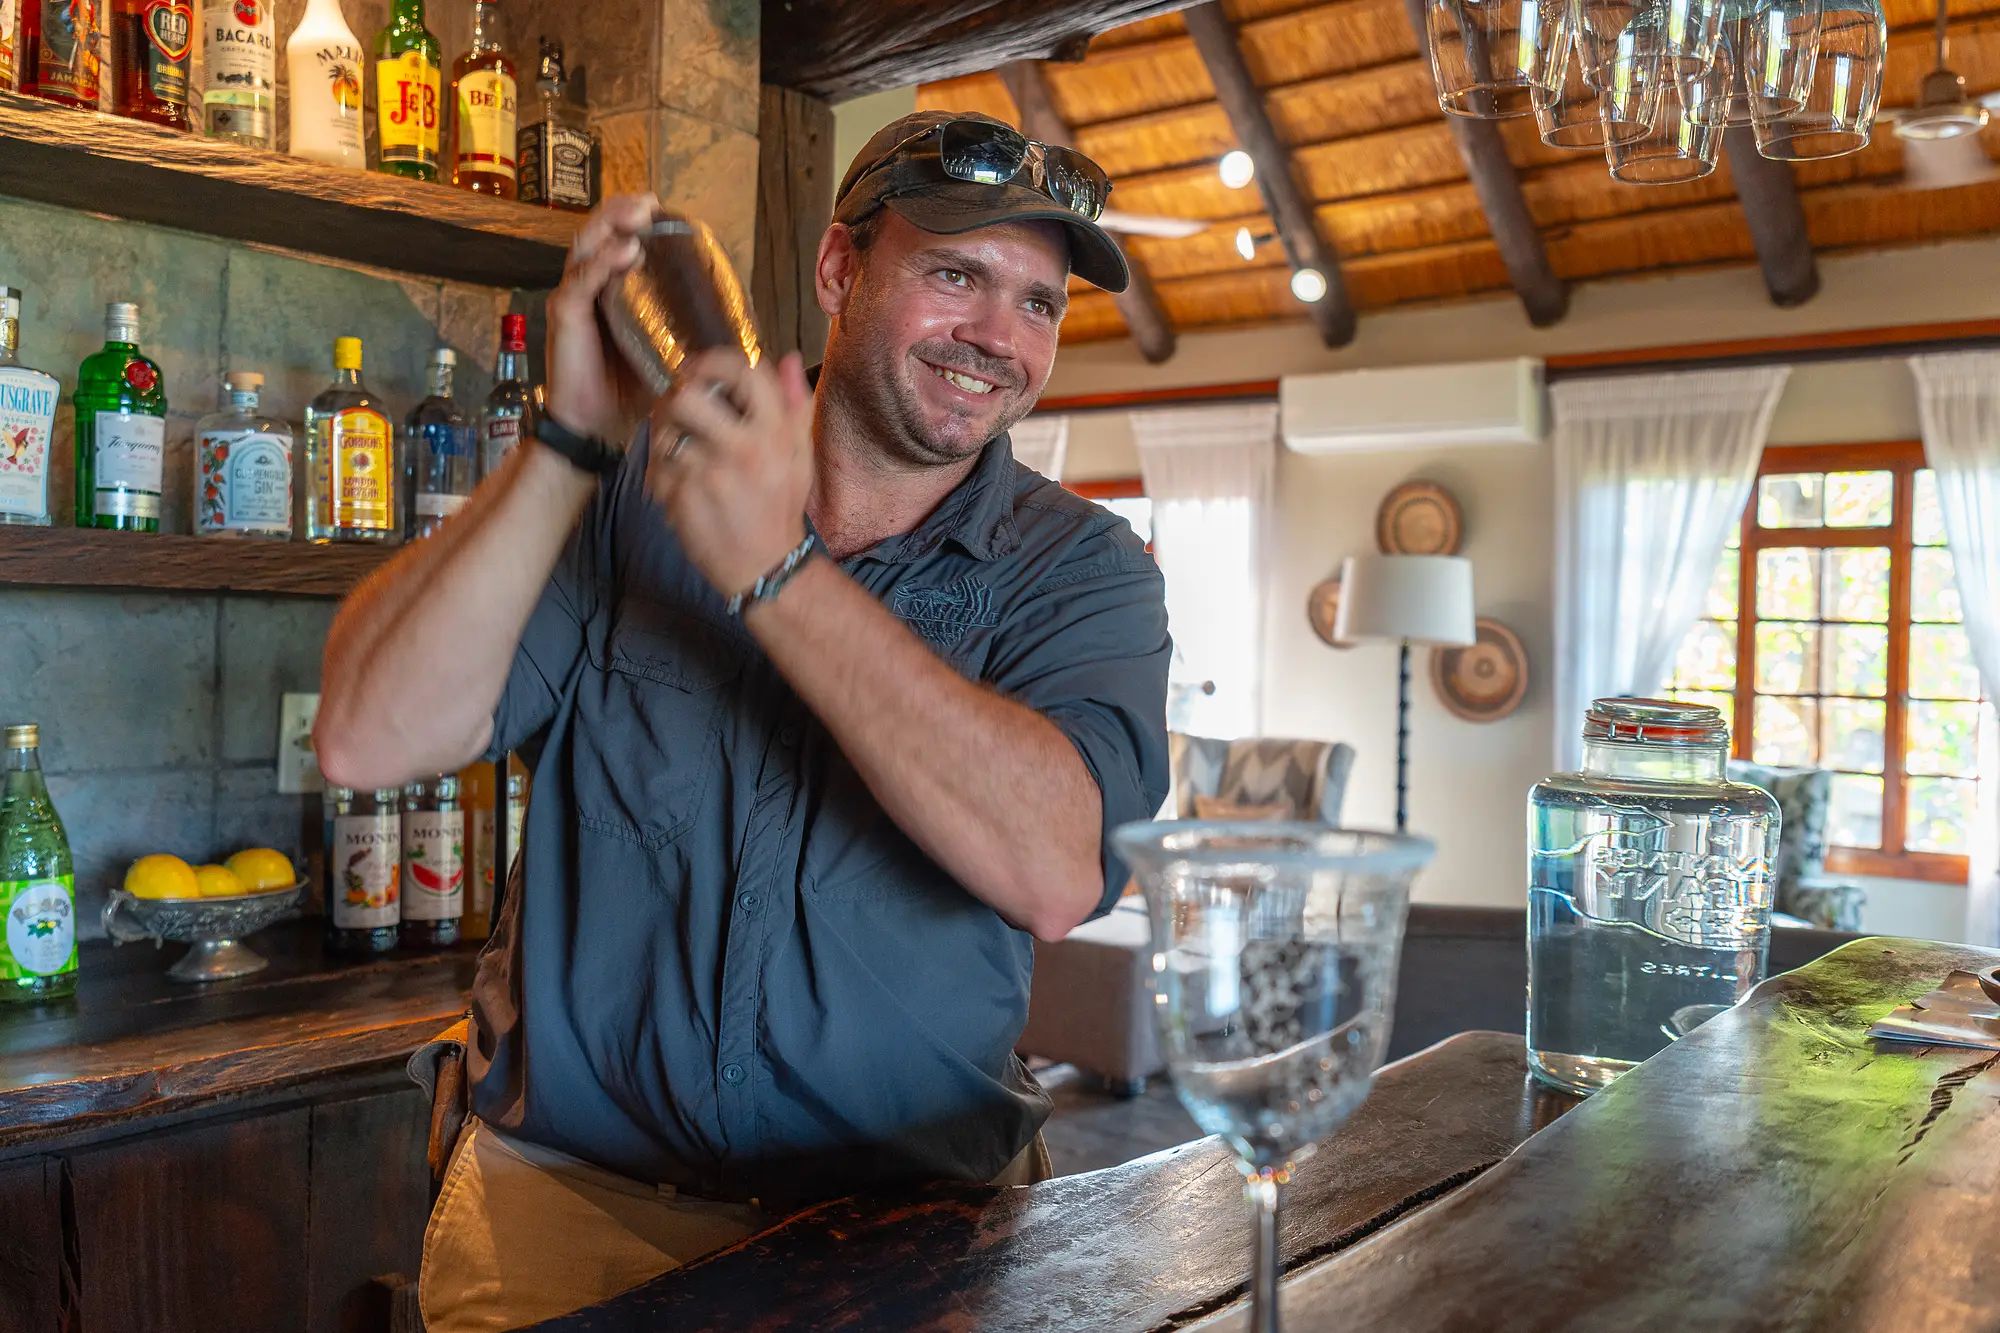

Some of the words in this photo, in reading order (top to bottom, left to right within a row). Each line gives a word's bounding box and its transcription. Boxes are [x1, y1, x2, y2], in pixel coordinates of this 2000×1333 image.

[160, 12, 187, 35] RED
[390, 80, 435, 129] J&B
[0, 384, 52, 416] USGRAVE
[254, 480, 273, 494] GIN
